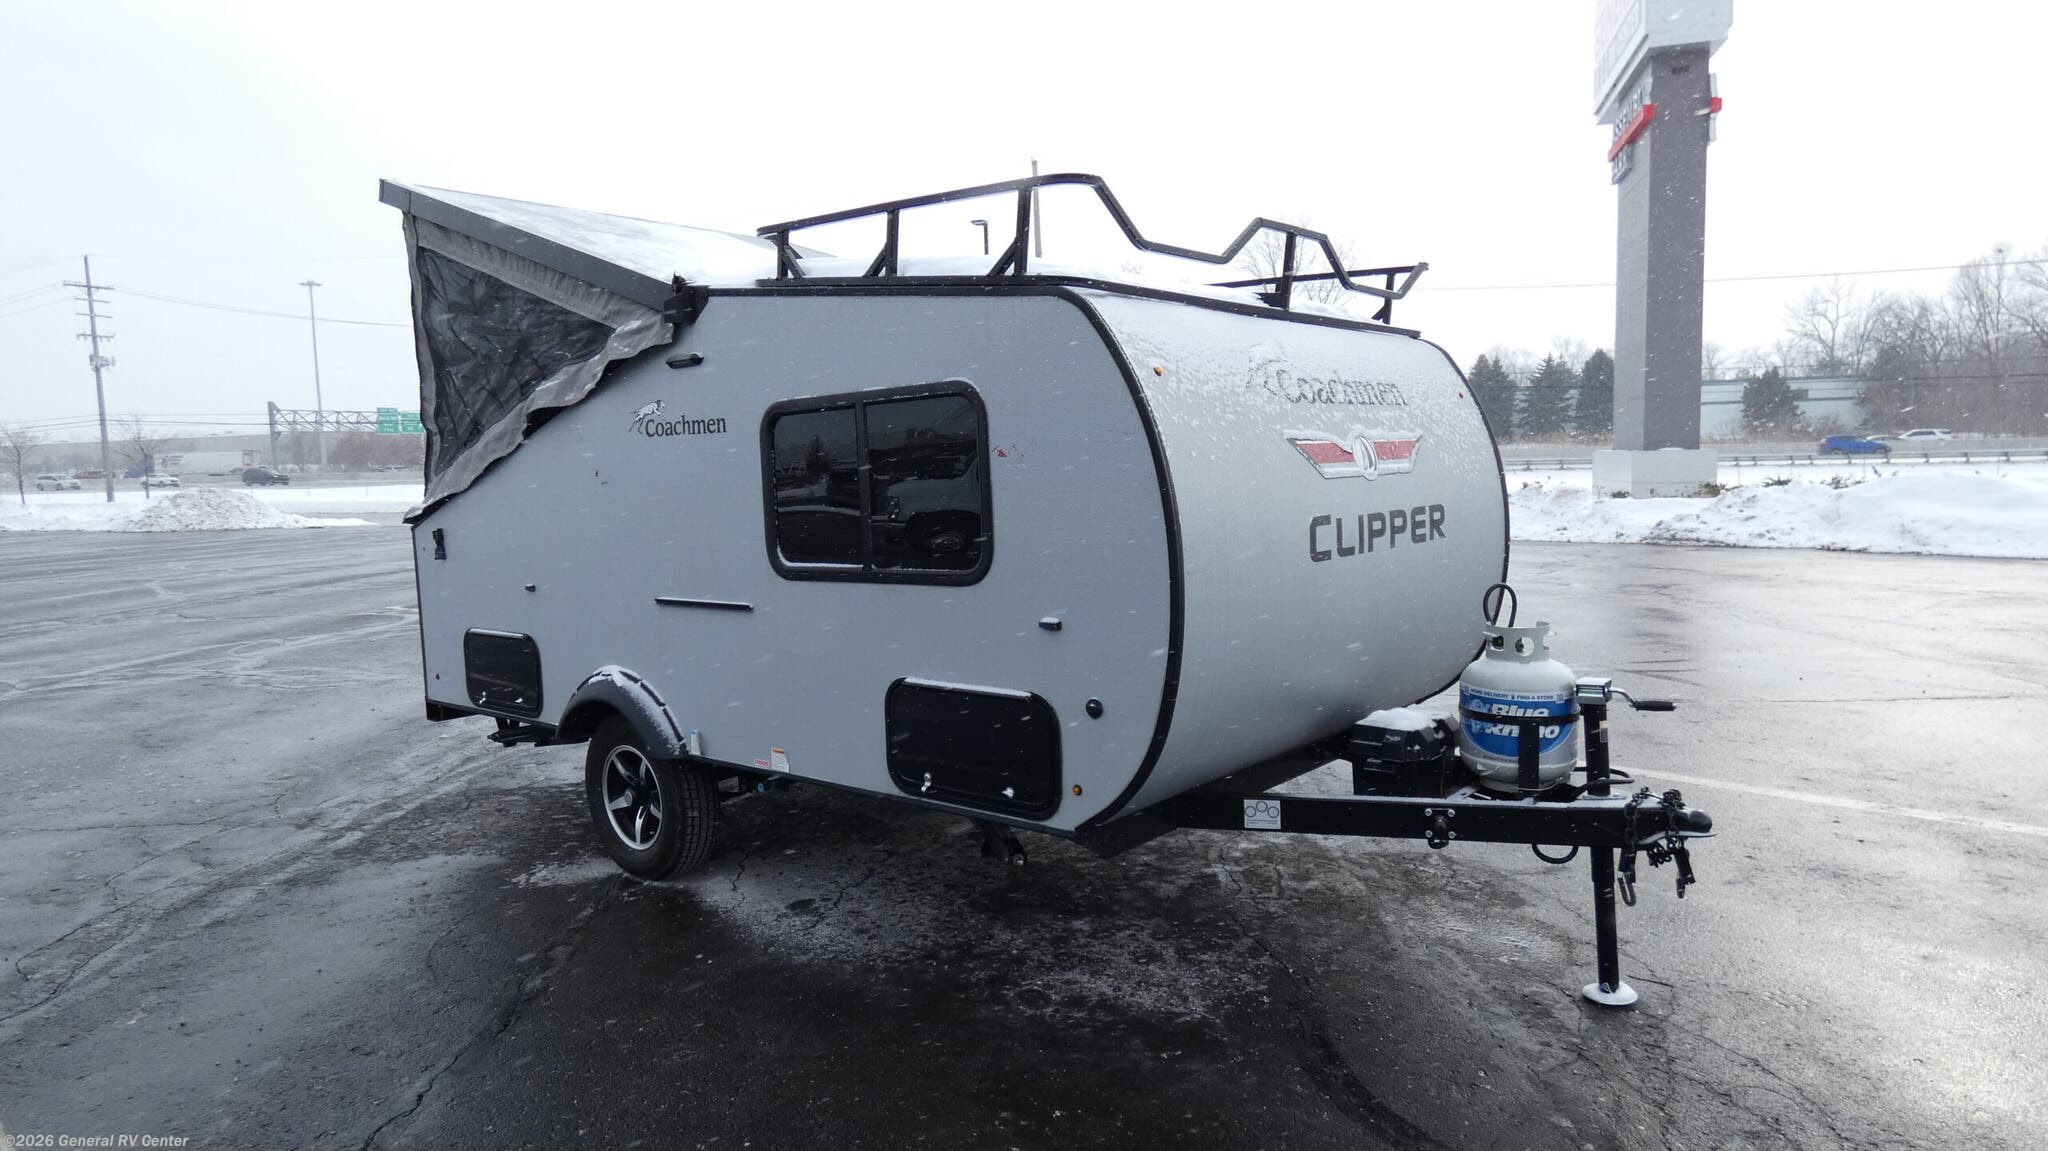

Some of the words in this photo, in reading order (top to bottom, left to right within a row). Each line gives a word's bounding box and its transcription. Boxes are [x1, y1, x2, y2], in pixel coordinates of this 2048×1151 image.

[1275, 369, 1408, 406] Coachmen
[645, 415, 727, 437] Coachmen
[1310, 504, 1446, 562] CLIPPER
[1484, 690, 1508, 699] DELIVERY
[1492, 703, 1549, 717] Blue
